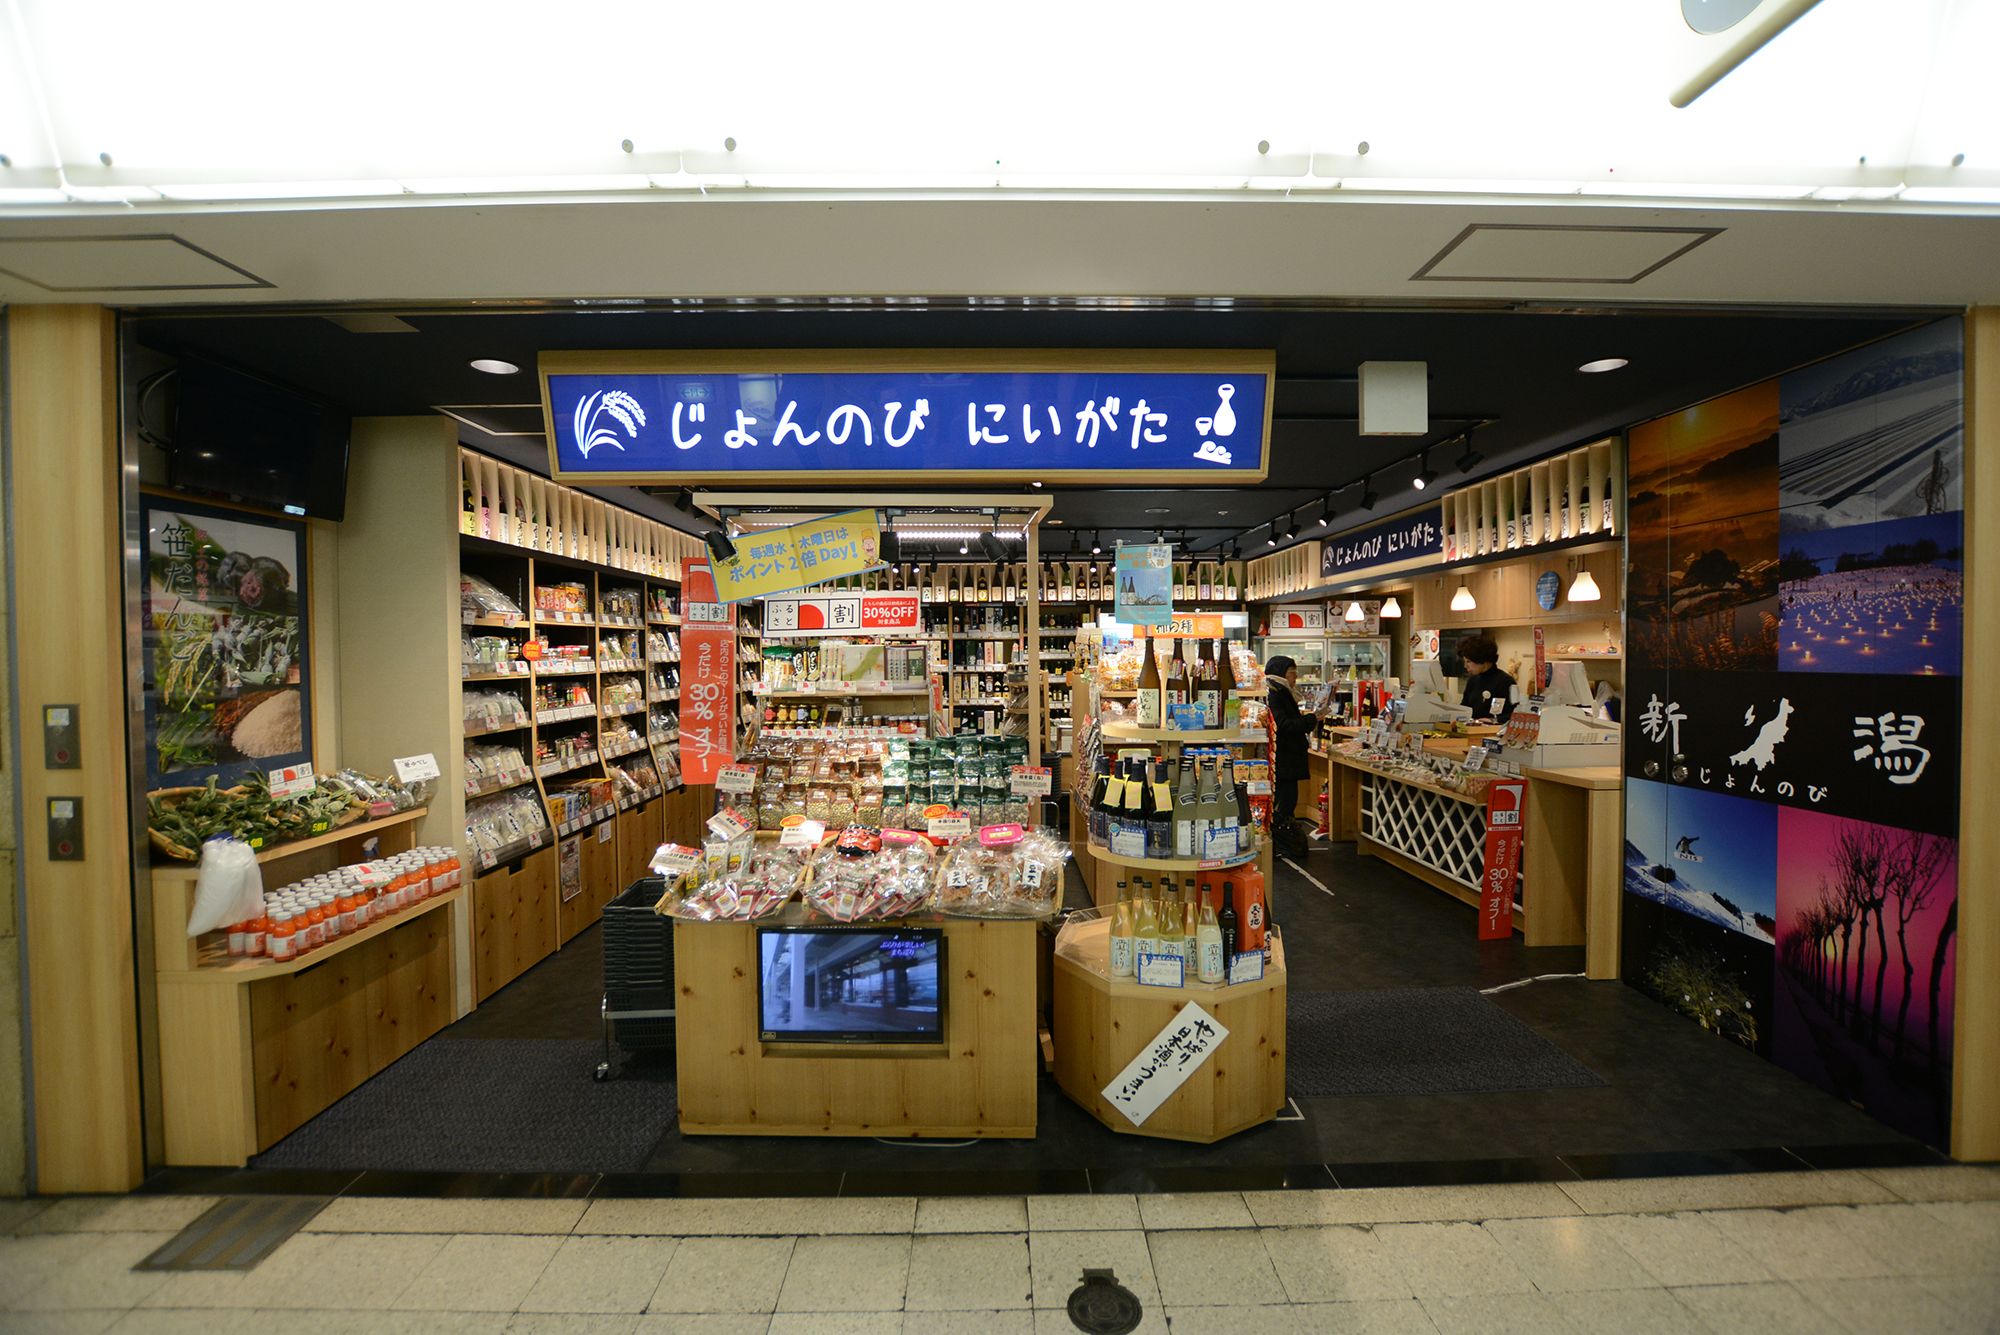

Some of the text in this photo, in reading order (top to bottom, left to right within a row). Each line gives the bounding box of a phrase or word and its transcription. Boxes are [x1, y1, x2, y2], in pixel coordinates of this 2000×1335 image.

[672, 396, 1169, 451] じょんのび にいがた
[750, 527, 849, 560] 毎週水・木曜日は
[1336, 522, 1434, 566] じょんのび にいがた
[161, 523, 196, 661] 笹だんご
[834, 604, 854, 624] 割
[863, 606, 915, 619] 30%OFF
[698, 642, 711, 678] 今だけ
[1639, 693, 1931, 785] 新 潟
[1700, 766, 1829, 803] じょんのび
